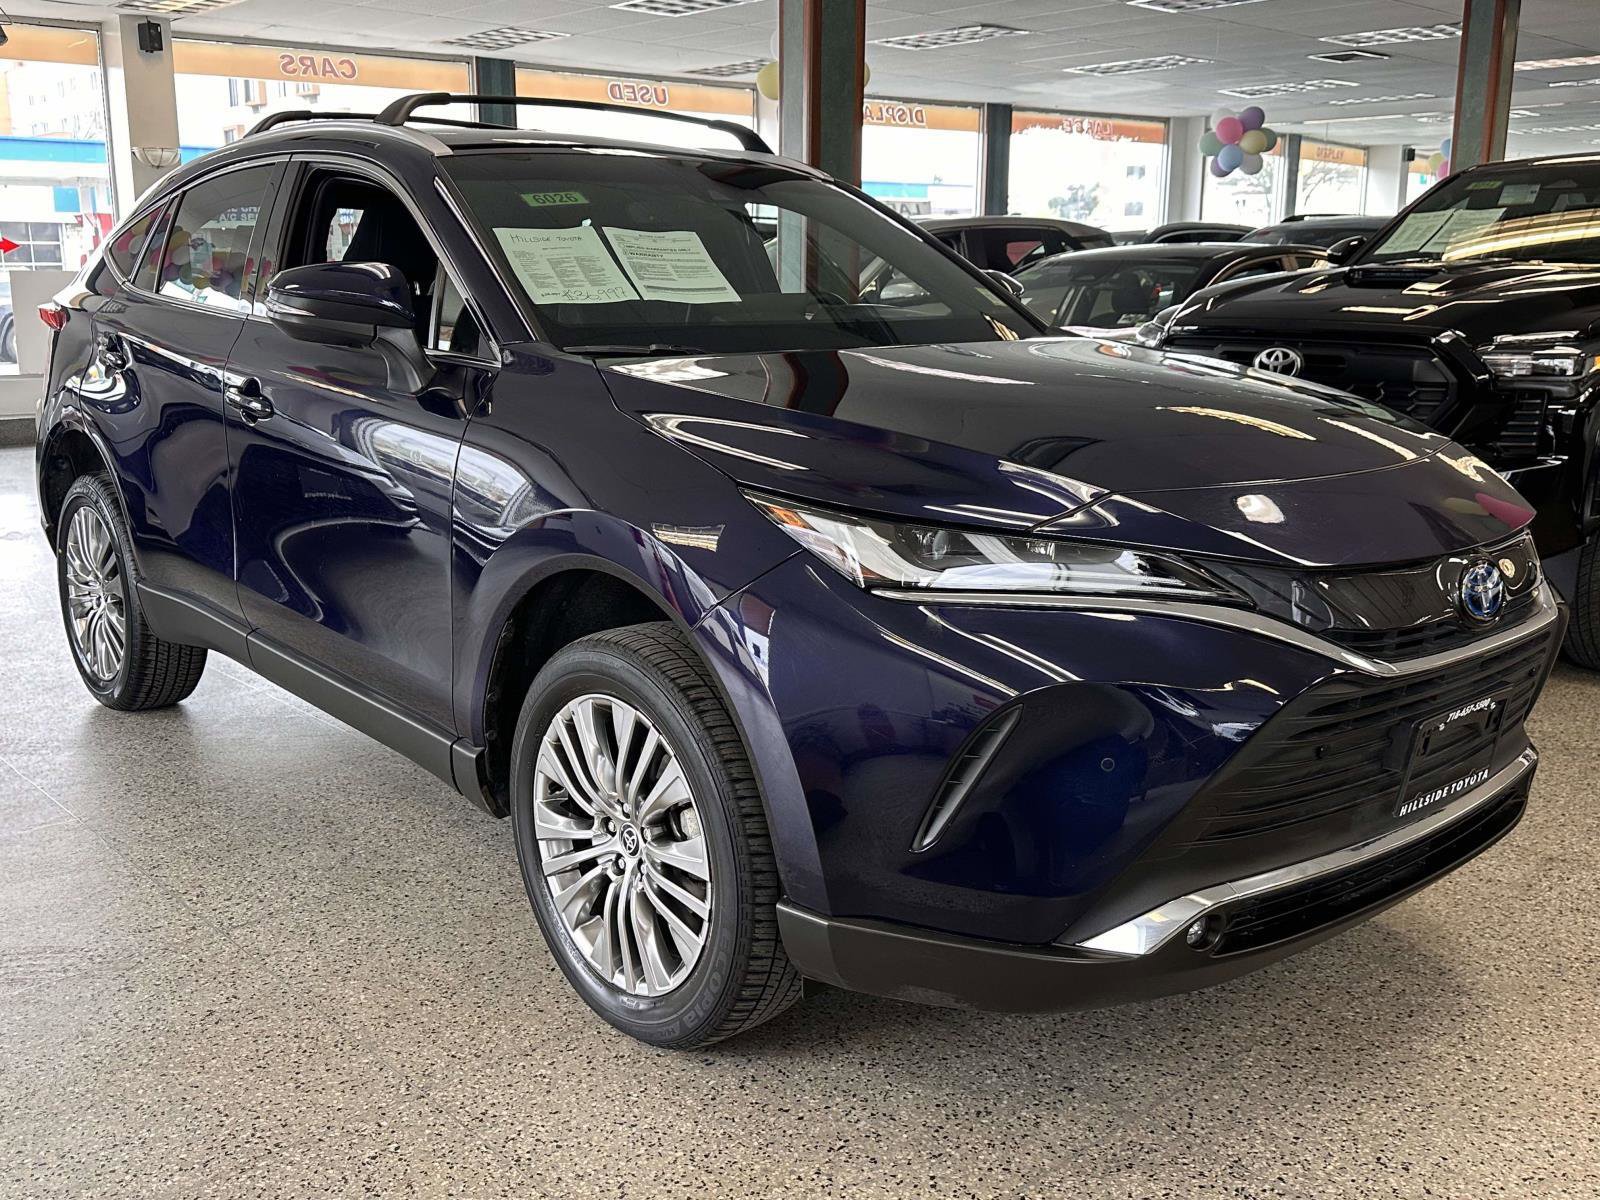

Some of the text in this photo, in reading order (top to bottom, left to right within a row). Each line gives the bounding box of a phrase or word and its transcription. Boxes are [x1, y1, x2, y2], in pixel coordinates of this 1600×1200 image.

[533, 192, 579, 204] 6026
[1399, 768, 1489, 817] HILLSIDE TOYOTA
